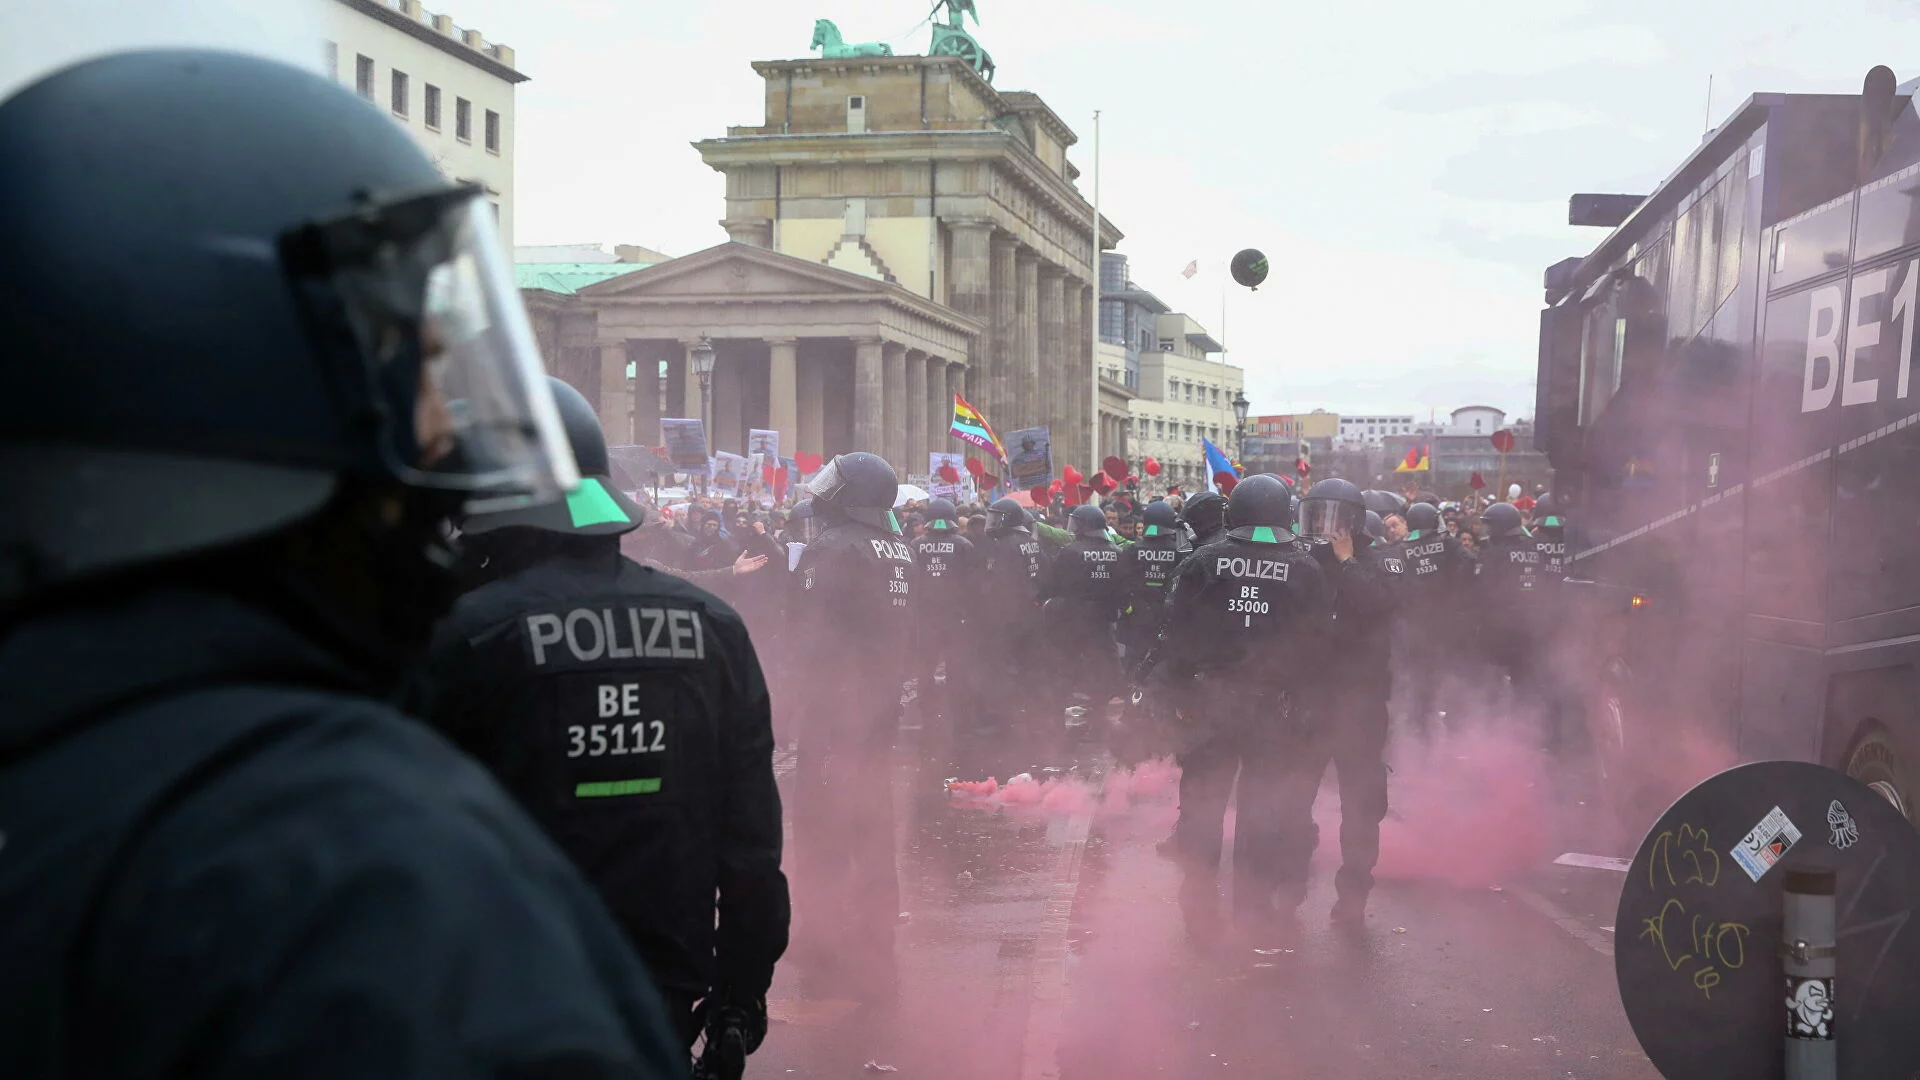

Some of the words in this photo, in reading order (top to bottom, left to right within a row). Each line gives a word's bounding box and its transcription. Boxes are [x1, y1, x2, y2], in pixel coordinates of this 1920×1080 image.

[961, 432, 985, 446] PAIX
[919, 542, 954, 553] POLIZEI
[1405, 542, 1445, 559] POLIZEI
[1536, 542, 1565, 554] POLIZ
[1083, 550, 1118, 561] POLIZEI
[1137, 549, 1175, 561] POLIZEI
[1419, 558, 1431, 566] BE
[894, 566, 904, 579] BE
[1216, 557, 1290, 582] POLIZEI
[888, 580, 909, 594] 35300
[1240, 586, 1259, 599] BE
[1228, 599, 1269, 614] 35000
[526, 607, 705, 665] POLIZEI
[597, 683, 641, 718] BE
[567, 720, 666, 758] 35112
[1743, 832, 1761, 851] CE
